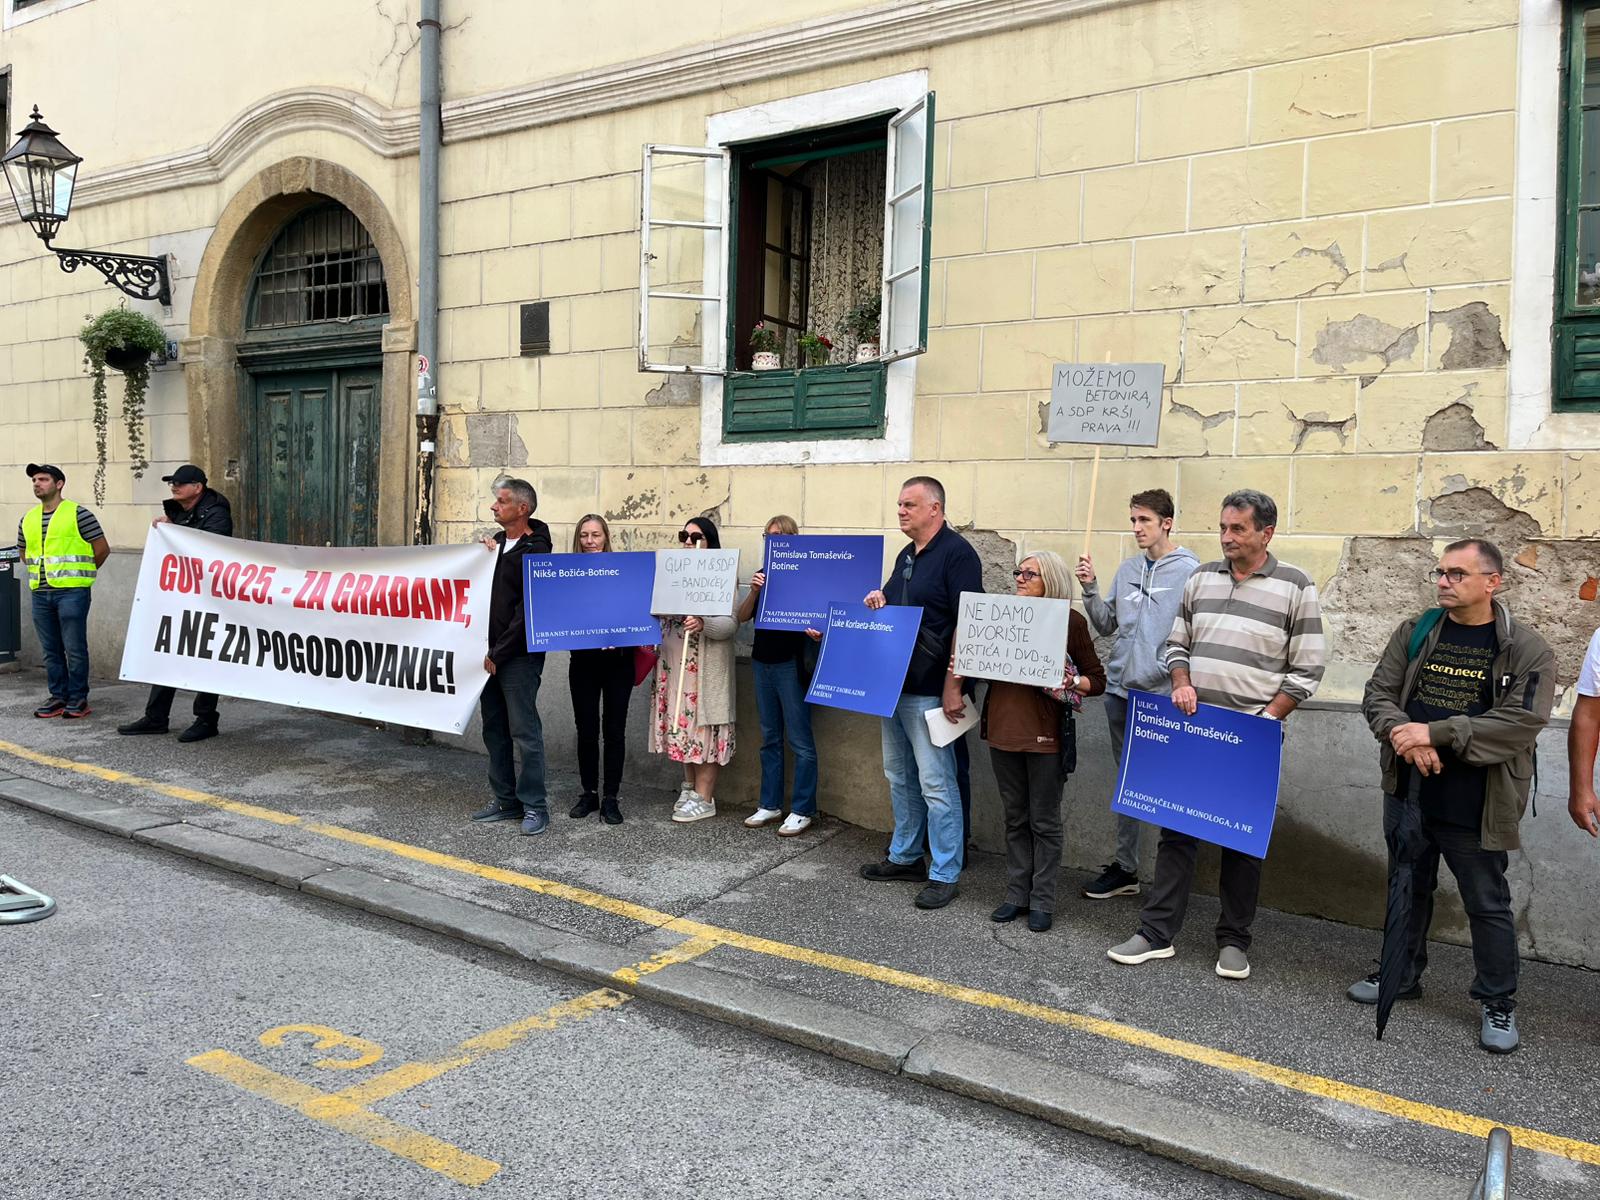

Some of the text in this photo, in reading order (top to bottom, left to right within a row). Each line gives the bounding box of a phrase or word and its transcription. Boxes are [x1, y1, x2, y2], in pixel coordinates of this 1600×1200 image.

[1057, 366, 1136, 387] MOŽEMO
[1085, 389, 1151, 408] BETONIRA,
[1056, 405, 1133, 418] A SDP KRŠI
[1081, 422, 1121, 433] PRAVA
[772, 550, 855, 560] Tomislava Tomaševića-
[533, 568, 620, 578] Nikše Božića-Botinec
[665, 557, 691, 574] GUP
[771, 561, 799, 570] Botinec
[159, 553, 204, 595] GUP
[208, 559, 277, 605] 2025.
[293, 570, 332, 610] ZA
[331, 572, 472, 628] GRAĐANE,
[685, 591, 715, 602] MODEL
[763, 616, 811, 625] GRADONAČELNIK
[964, 603, 1034, 624] NE DAMO
[831, 619, 845, 628] Luke
[968, 624, 1031, 643] DVORIŠTE
[154, 610, 456, 695] A NE ZA POGODOVANJE!
[959, 643, 1000, 658] VRTIĆA
[957, 659, 974, 671] NE
[978, 661, 1012, 676] DAMO
[1019, 665, 1050, 679] KUĆE
[1137, 700, 1158, 711] ULICA
[1135, 726, 1170, 744] Botinec
[1137, 711, 1243, 745] Tomislava Tomaševića-
[1122, 798, 1156, 814] DIJALOGA
[1124, 789, 1253, 834] GRADONAČELNIK MONOLOGA, A NE
